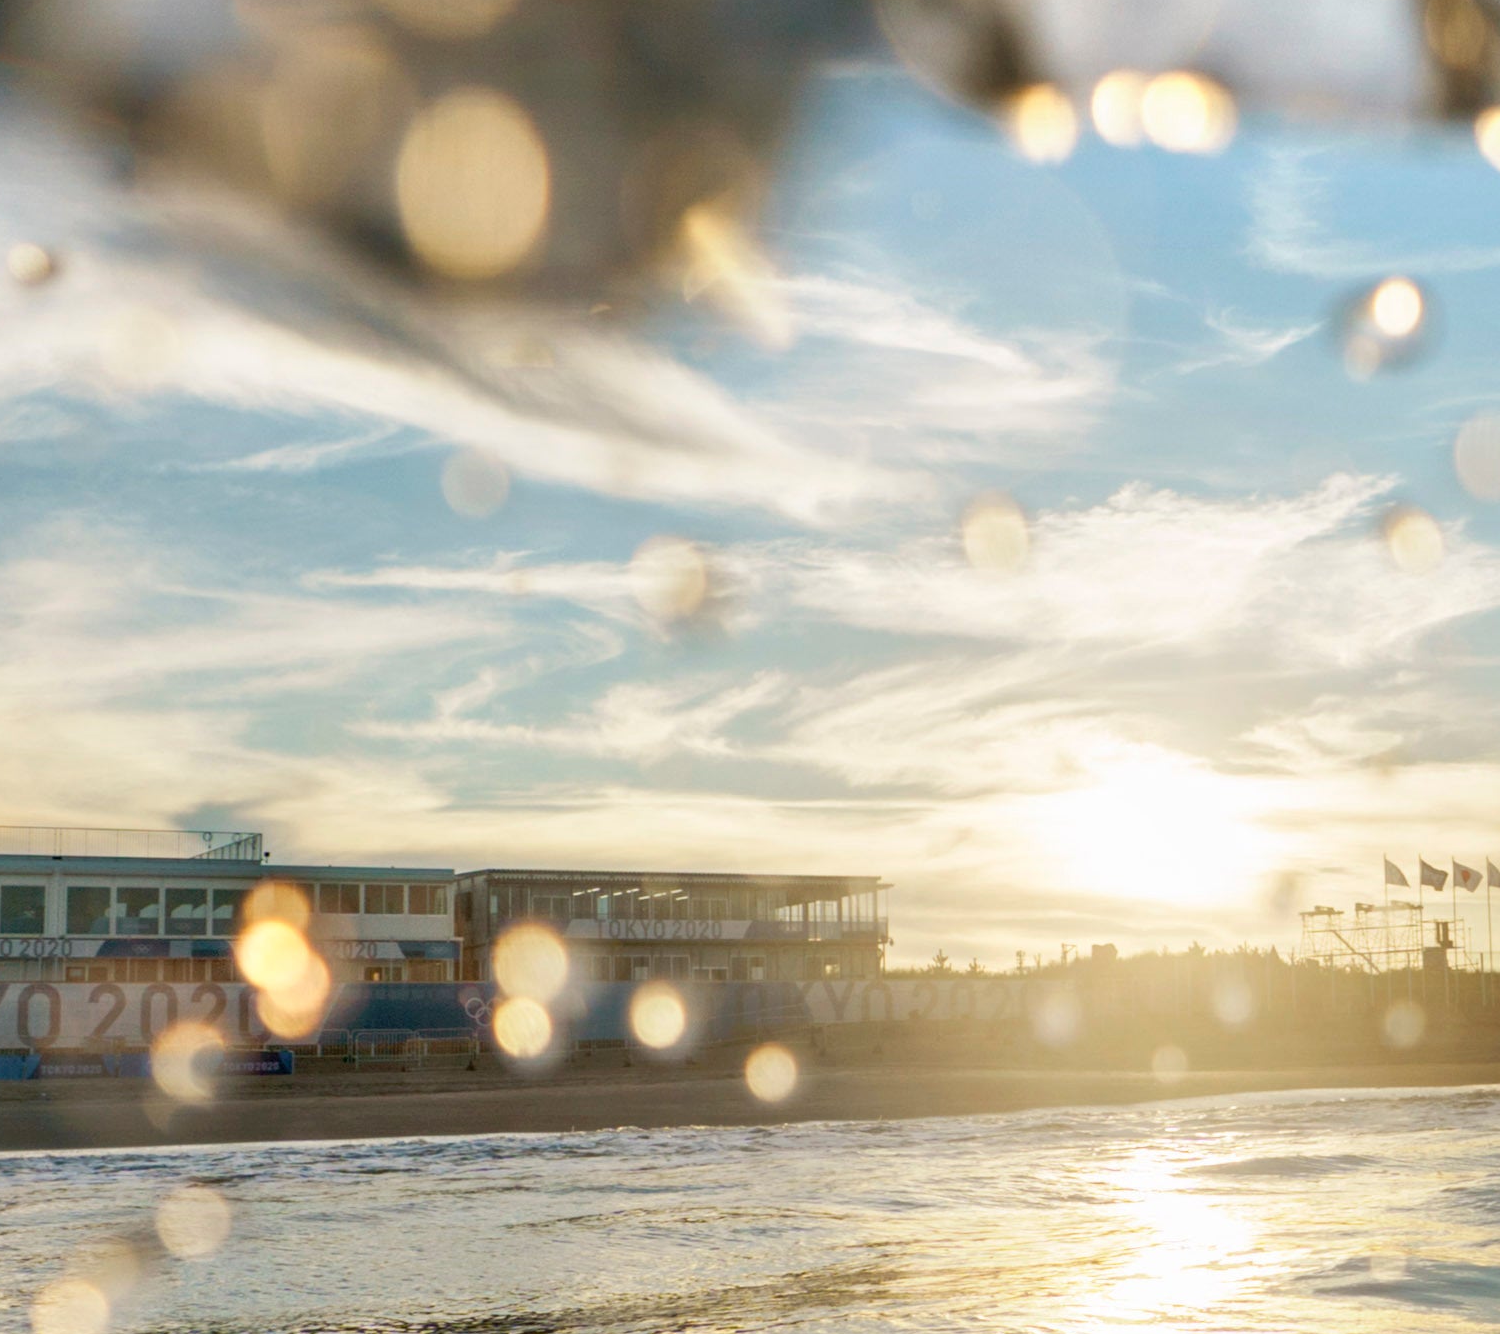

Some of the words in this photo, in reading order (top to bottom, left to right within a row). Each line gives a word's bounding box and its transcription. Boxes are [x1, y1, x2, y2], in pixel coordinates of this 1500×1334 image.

[597, 919, 666, 939] TOKYO
[671, 919, 723, 939] 2020
[19, 938, 73, 958] 2020
[41, 1065, 76, 1075] TOKYO
[77, 1065, 102, 1074] 2020
[255, 1062, 280, 1071] 2020
